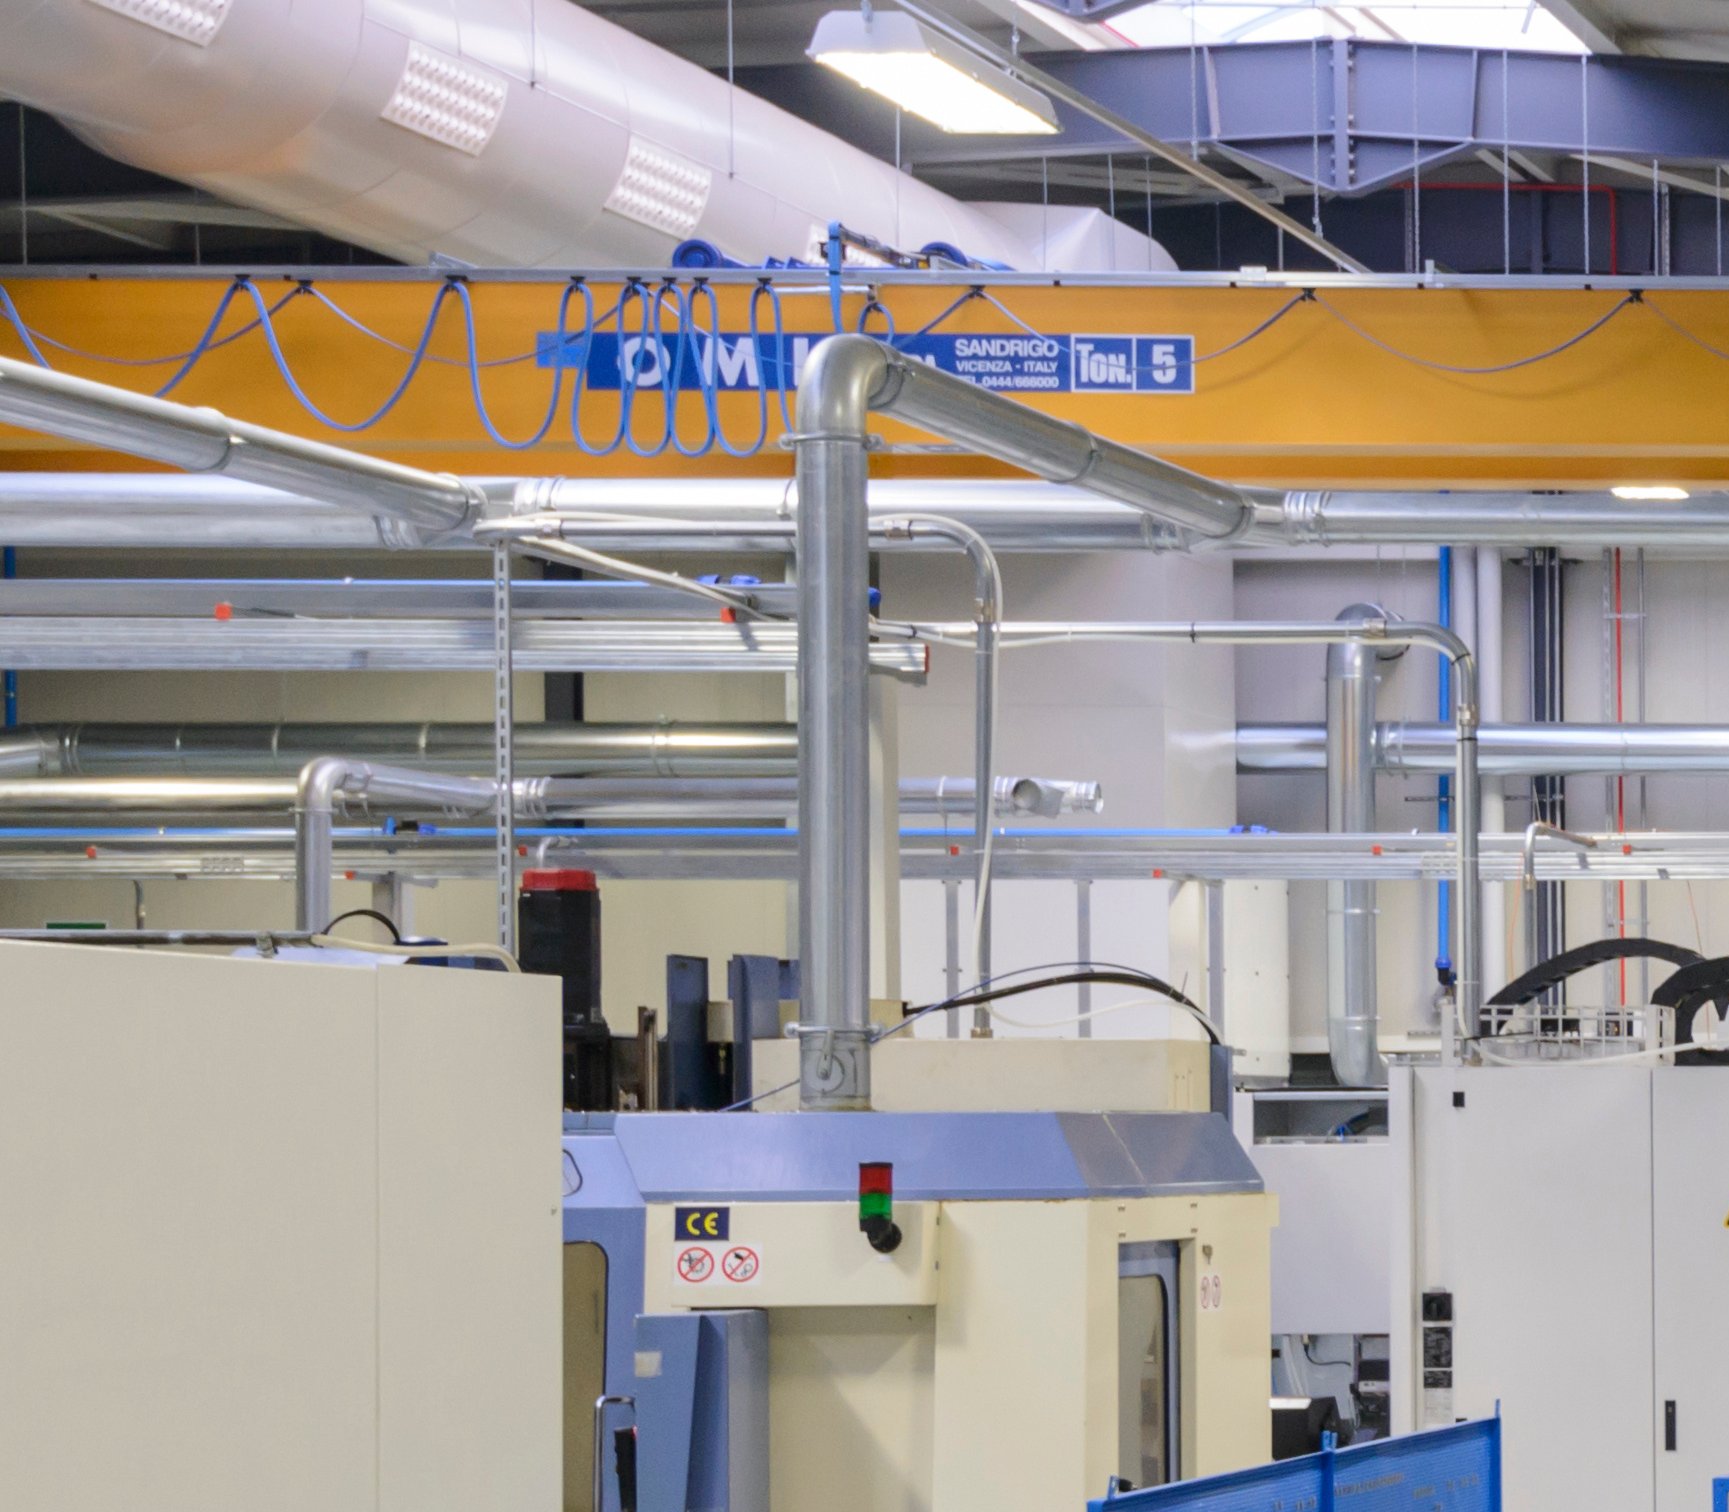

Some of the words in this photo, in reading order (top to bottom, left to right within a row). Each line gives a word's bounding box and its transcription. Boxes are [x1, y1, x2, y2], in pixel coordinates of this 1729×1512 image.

[955, 338, 1059, 357] SANDRIGO
[955, 360, 1012, 373] VICENZA
[1023, 360, 1058, 372] ITALY
[1152, 344, 1177, 384] 5
